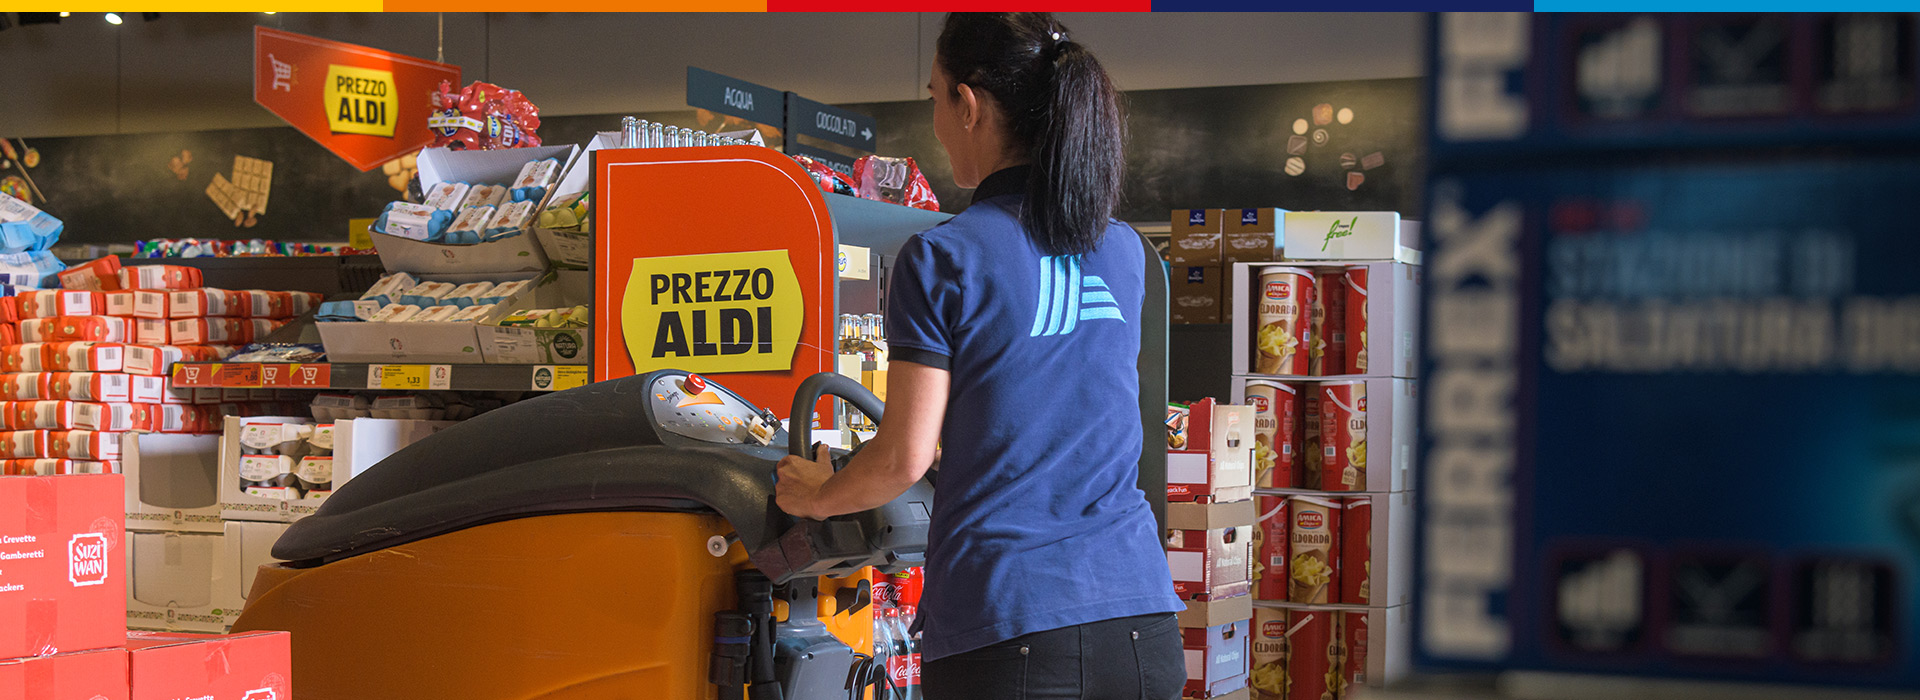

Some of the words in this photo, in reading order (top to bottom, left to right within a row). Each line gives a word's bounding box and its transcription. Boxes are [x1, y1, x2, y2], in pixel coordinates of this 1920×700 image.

[336, 75, 387, 98] PREZZO
[723, 86, 754, 112] ACQUA
[337, 97, 387, 126] ALDI
[816, 110, 857, 138] CIOCCOLATO
[650, 267, 775, 305] PREZZO
[651, 306, 773, 358] ALDI
[1424, 200, 1522, 658] FERREX
[1298, 514, 1322, 522] AMICA
[3, 535, 37, 544] Crevette
[1292, 531, 1330, 544] ELDORADA
[0, 549, 45, 560] Gamberetti
[73, 559, 103, 577] WAN
